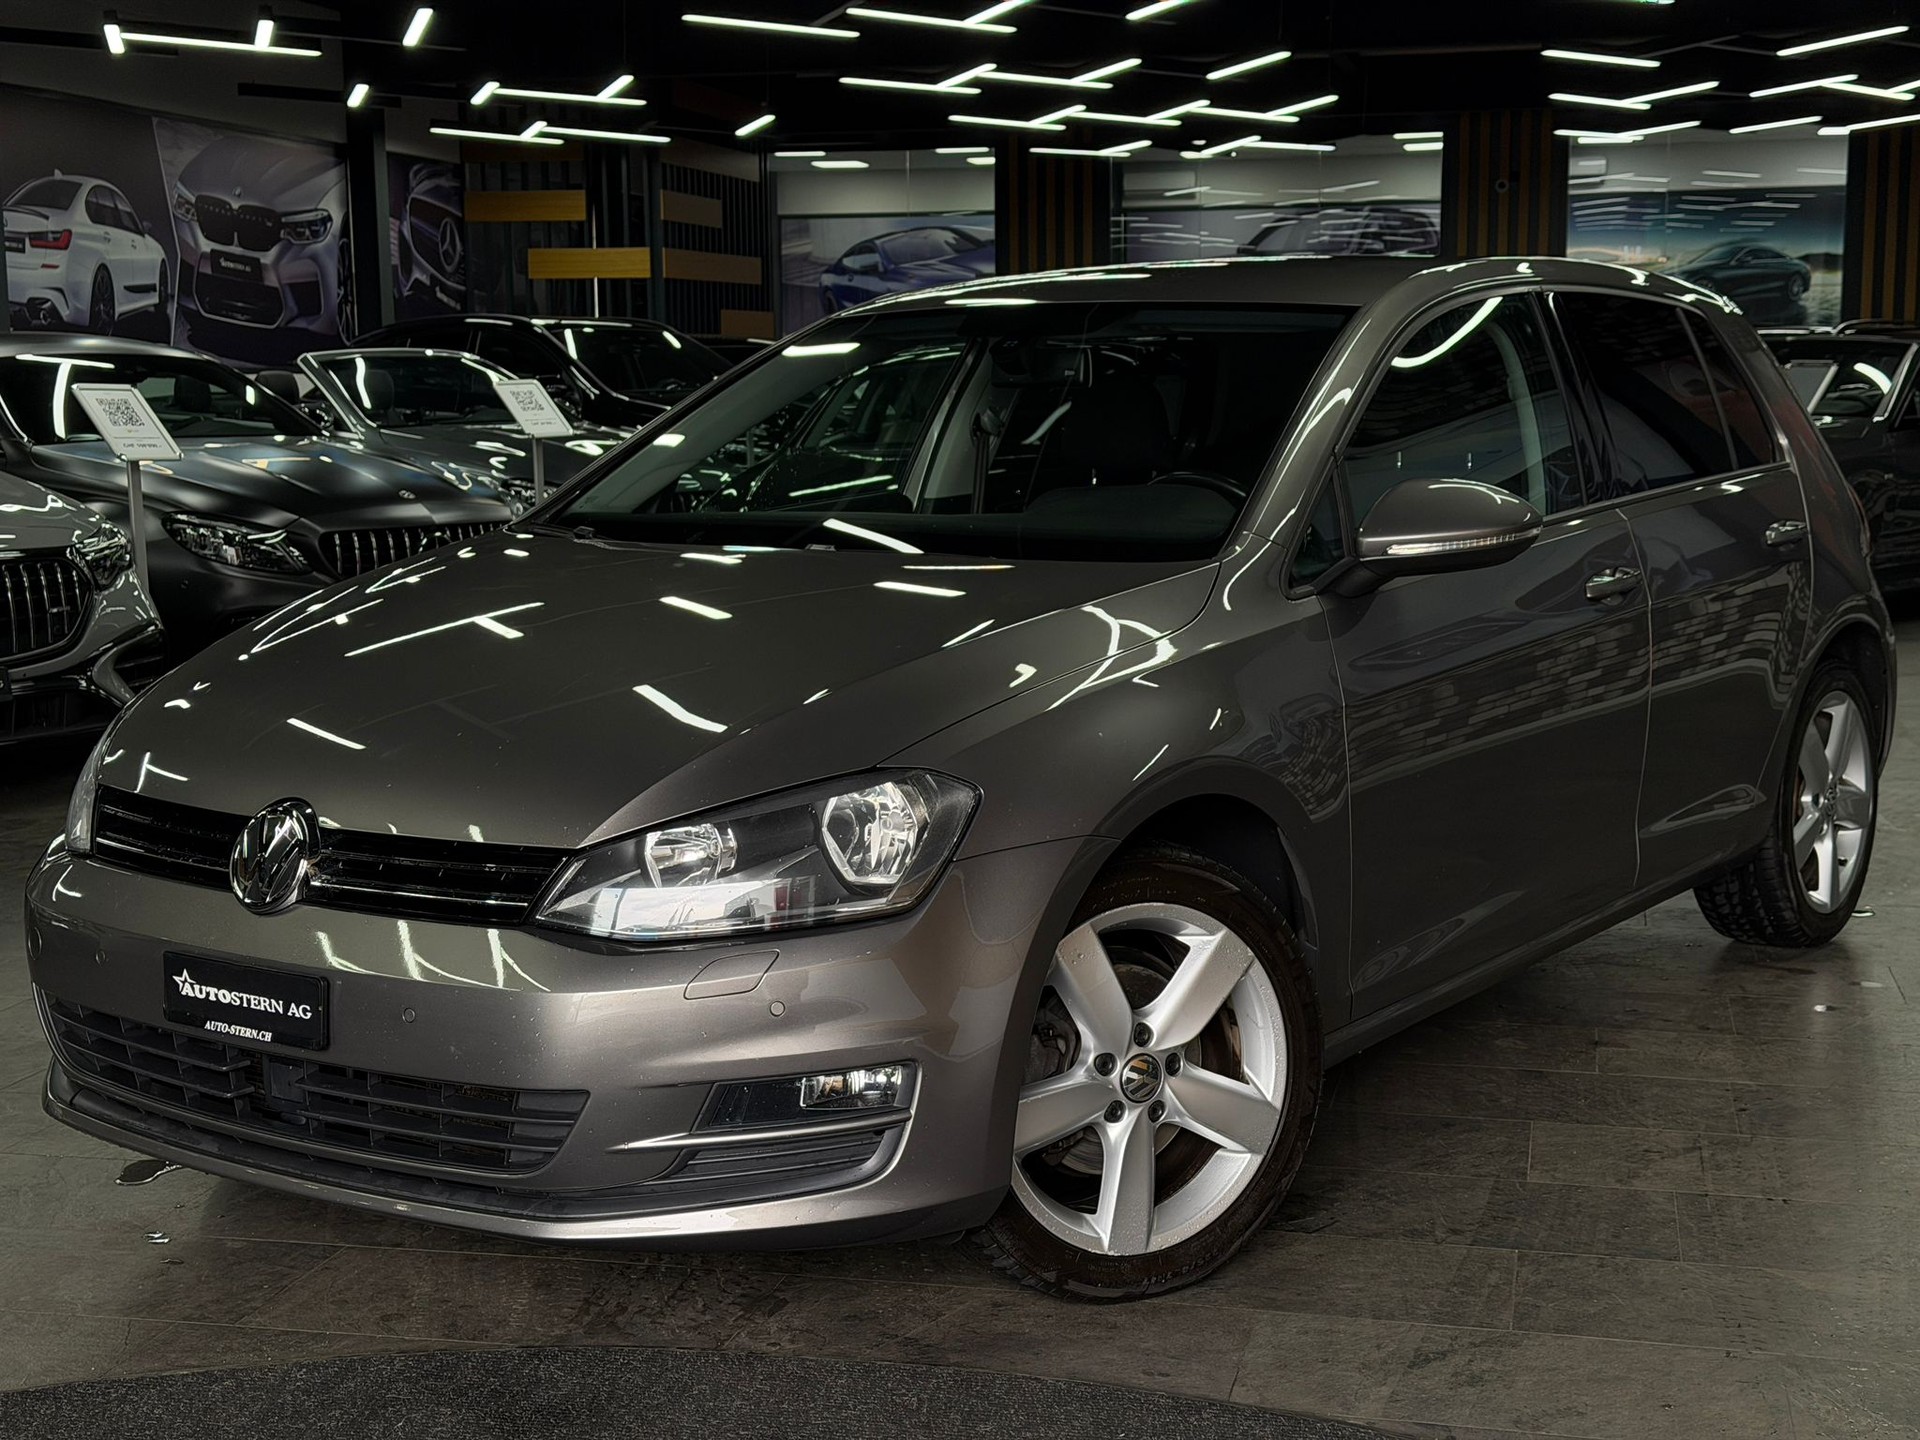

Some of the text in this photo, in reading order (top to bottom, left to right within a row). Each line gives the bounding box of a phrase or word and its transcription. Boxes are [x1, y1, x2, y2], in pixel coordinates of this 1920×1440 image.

[180, 980, 312, 1020] AUTOSTERN AG
[204, 1020, 272, 1042] AUTO-STERN.CH
